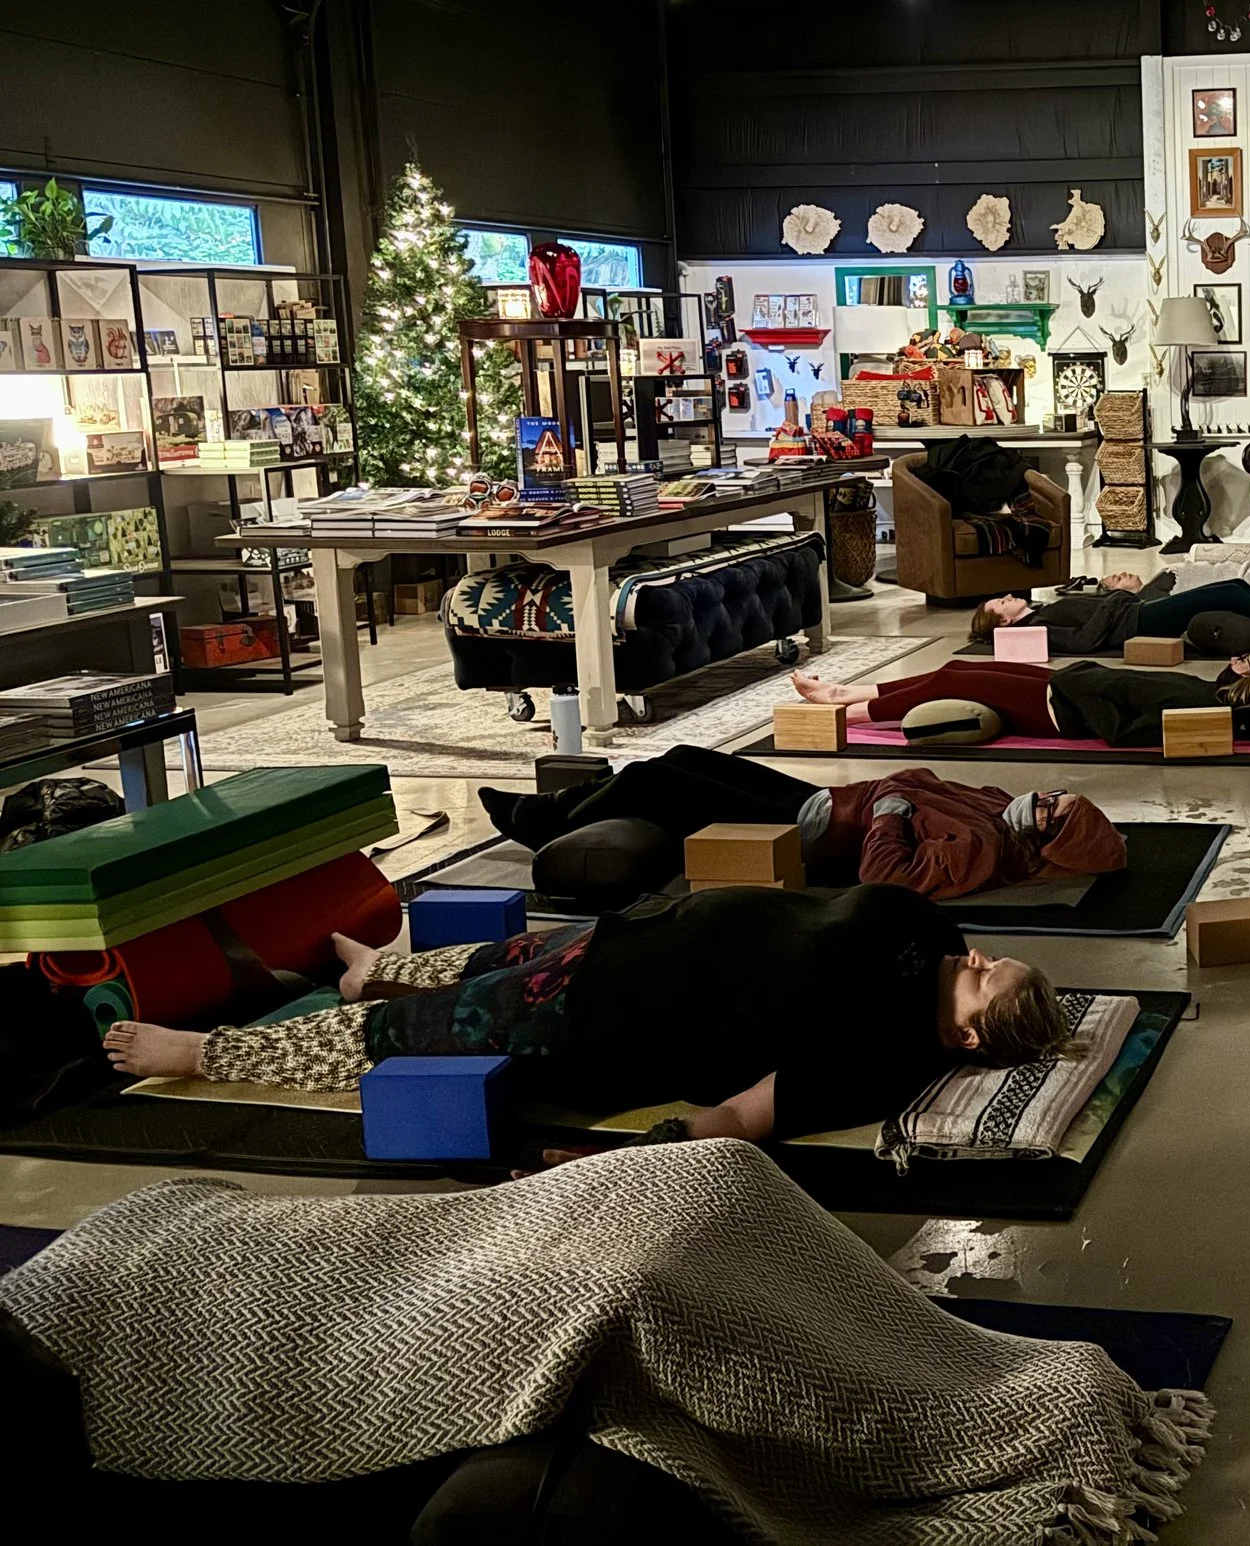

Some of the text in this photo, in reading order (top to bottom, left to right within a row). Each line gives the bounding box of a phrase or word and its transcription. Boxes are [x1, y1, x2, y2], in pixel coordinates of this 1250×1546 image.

[487, 529, 510, 537] LODGE
[90, 681, 152, 701] NEW AMERICANA
[93, 690, 153, 712] NEW AMERICANA
[94, 700, 154, 721] NEW AMERICANA
[95, 709, 156, 732] NEW AMERICANA
